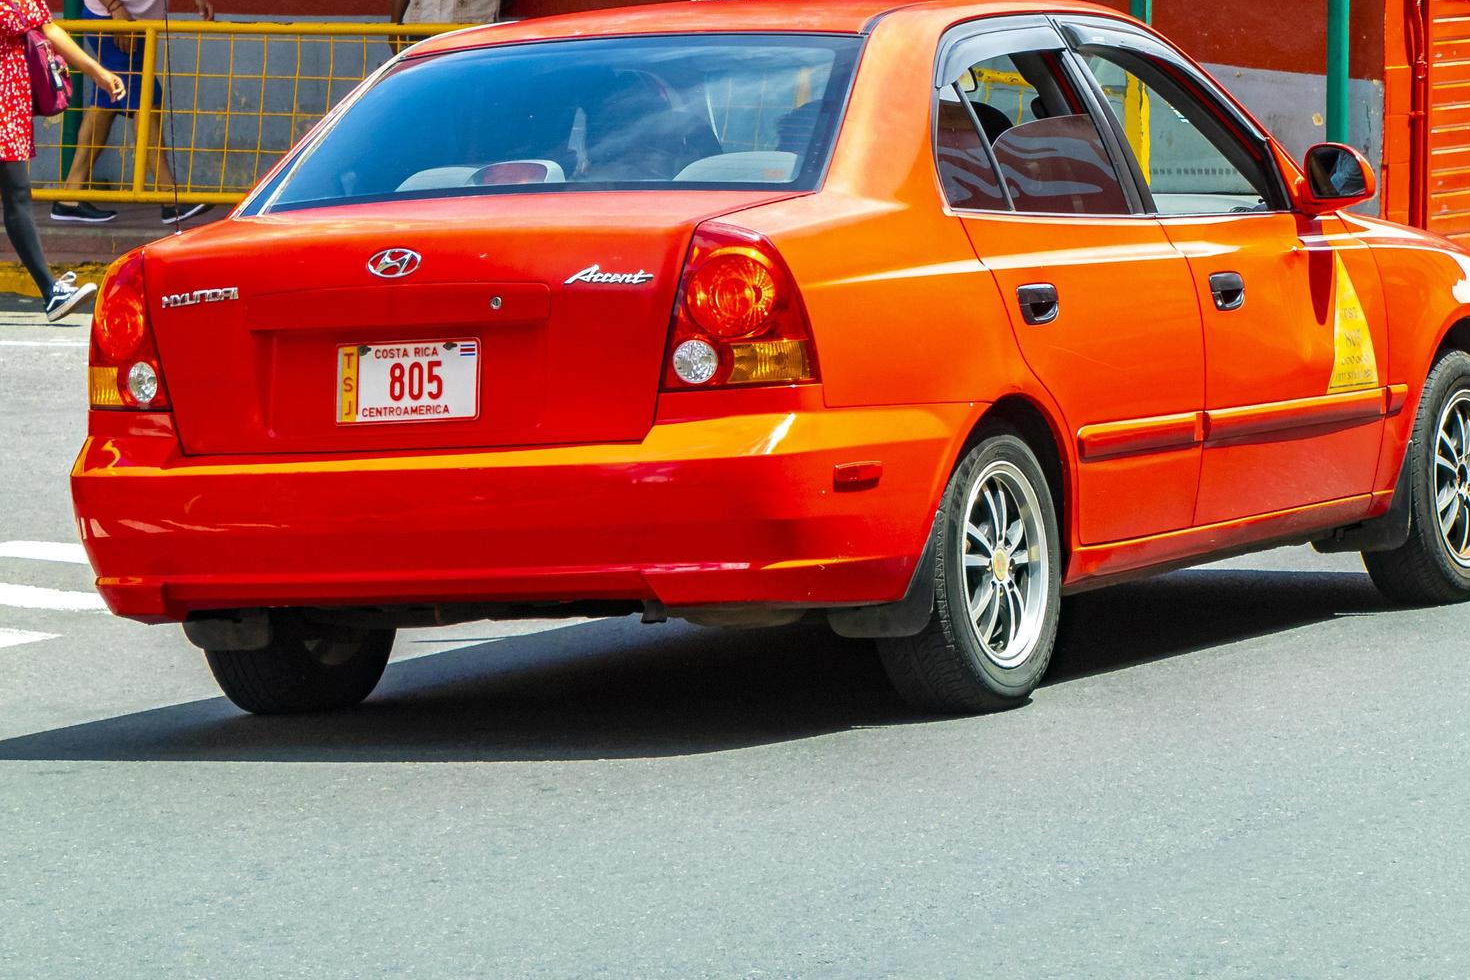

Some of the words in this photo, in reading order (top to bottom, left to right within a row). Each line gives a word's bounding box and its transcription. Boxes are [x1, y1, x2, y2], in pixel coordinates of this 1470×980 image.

[563, 264, 655, 285] Accent
[161, 287, 239, 309] HYUNDAI
[374, 348, 409, 360] COSTA
[413, 346, 439, 358] RICA
[342, 353, 354, 417] TSJ
[389, 360, 443, 402] 805
[361, 404, 450, 418] CENTROAMERICA
